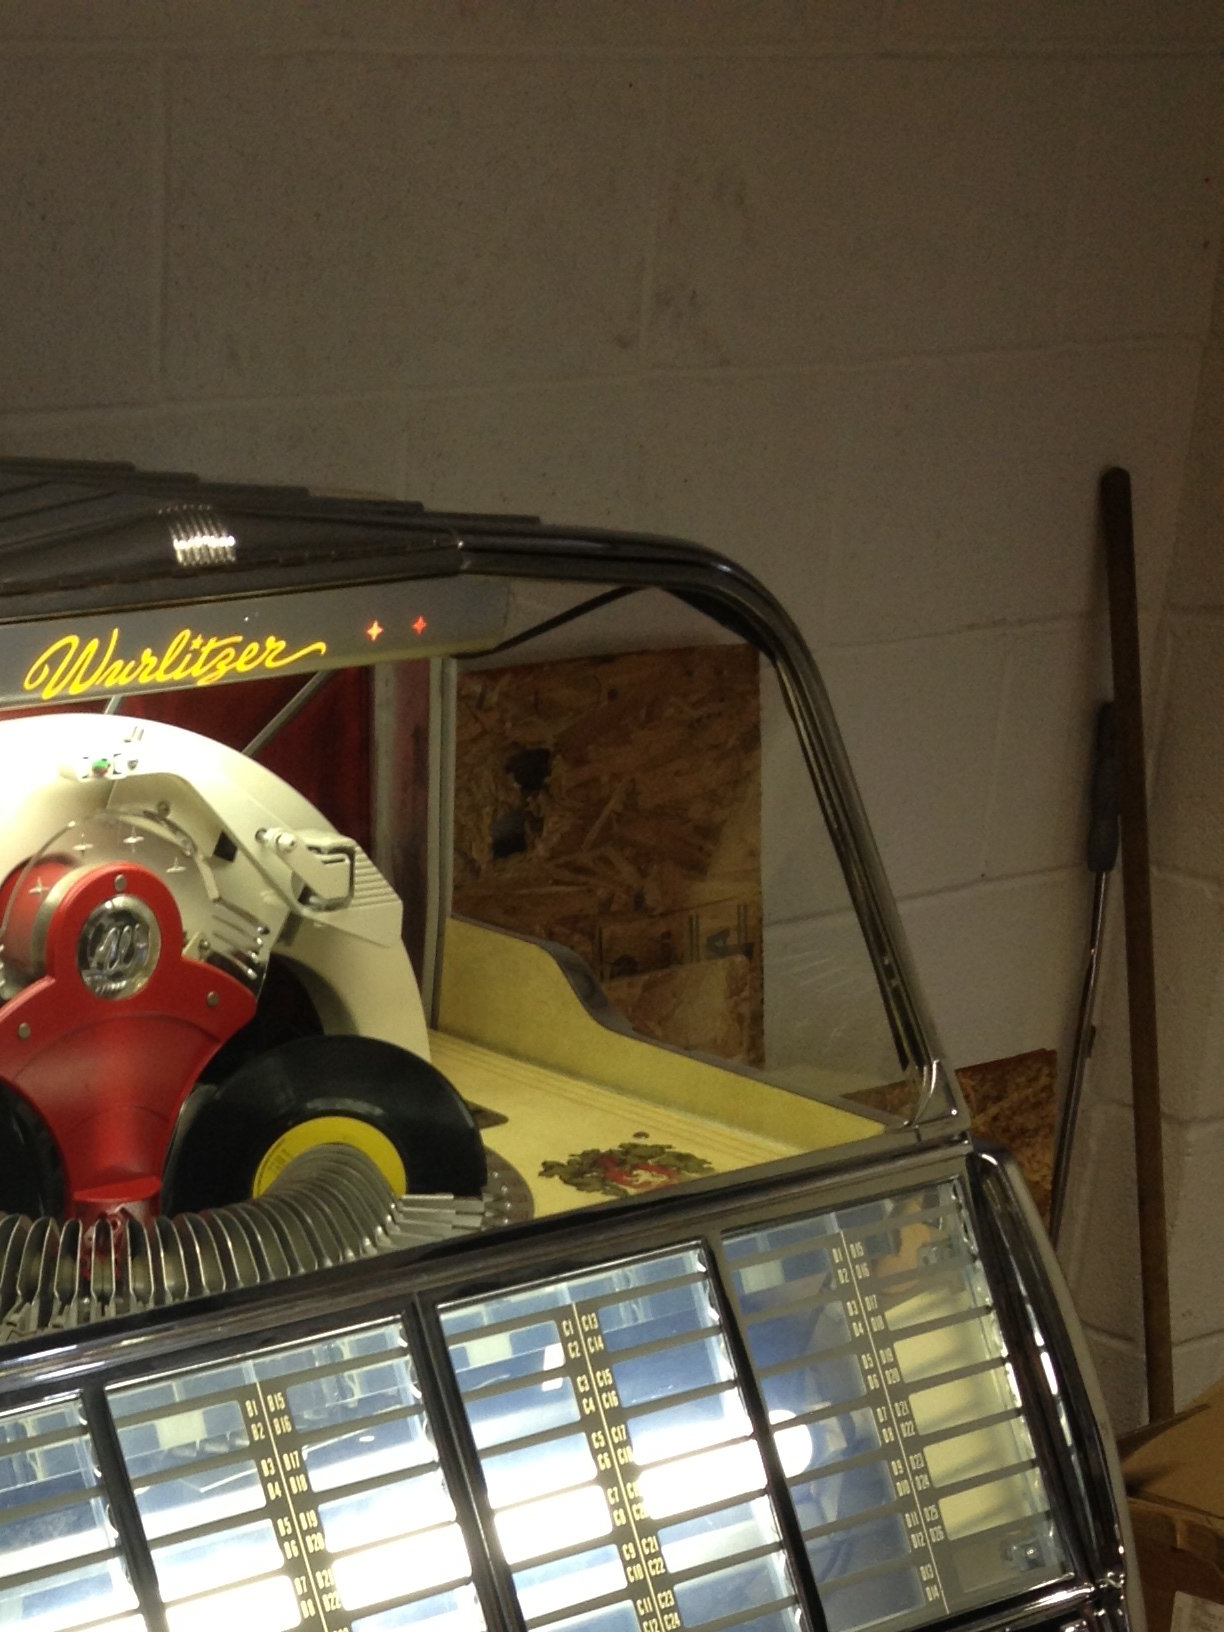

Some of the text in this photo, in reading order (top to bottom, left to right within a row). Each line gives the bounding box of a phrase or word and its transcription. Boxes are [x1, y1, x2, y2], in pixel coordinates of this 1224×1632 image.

[24, 627, 326, 700] Wurlitzer
[562, 1320, 574, 1336] C1
[581, 1313, 598, 1332] C13
[568, 1341, 580, 1359] C2
[587, 1335, 604, 1354] C14
[577, 1374, 589, 1393] C3
[596, 1368, 613, 1387] C15
[582, 1397, 595, 1415] C4
[602, 1390, 619, 1409] C16
[592, 1431, 606, 1449] C5
[611, 1424, 626, 1444] C17
[597, 1452, 611, 1471] C6
[607, 1486, 619, 1505] C7
[627, 1481, 642, 1499] C1
[613, 1508, 626, 1527] C8
[632, 1502, 650, 1521] C2
[623, 1542, 636, 1561] C9
[641, 1536, 658, 1555] C21
[627, 1563, 643, 1583] C10
[648, 1557, 665, 1576] C22
[636, 1597, 653, 1616] C11
[657, 1590, 674, 1609] C23
[664, 1612, 681, 1631] C24
